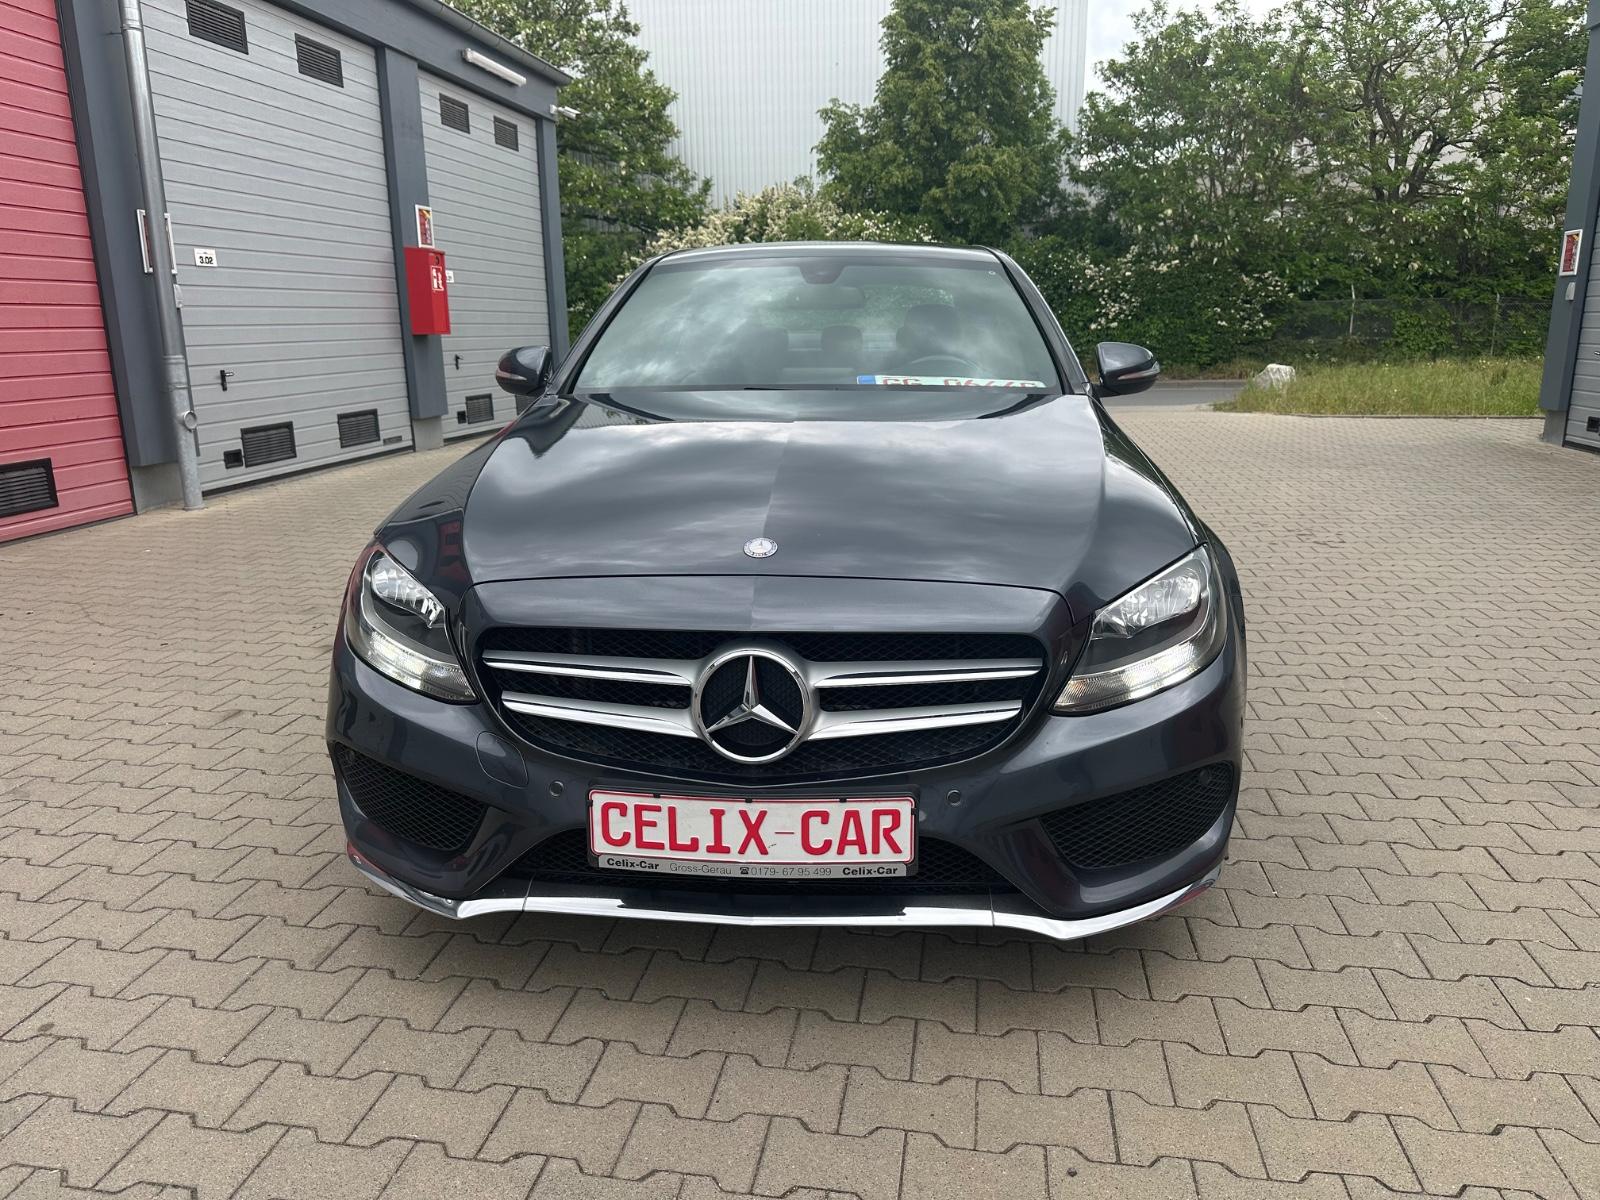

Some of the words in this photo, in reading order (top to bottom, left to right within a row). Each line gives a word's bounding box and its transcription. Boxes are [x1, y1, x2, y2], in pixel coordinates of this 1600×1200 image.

[199, 255, 214, 265] 3.02
[607, 858, 659, 870] Celix-Car
[669, 862, 732, 875] Gross-Gerau
[782, 866, 795, 876] 67
[798, 866, 811, 876] 95
[813, 866, 832, 876] 499
[842, 865, 898, 876] Celix-Car
